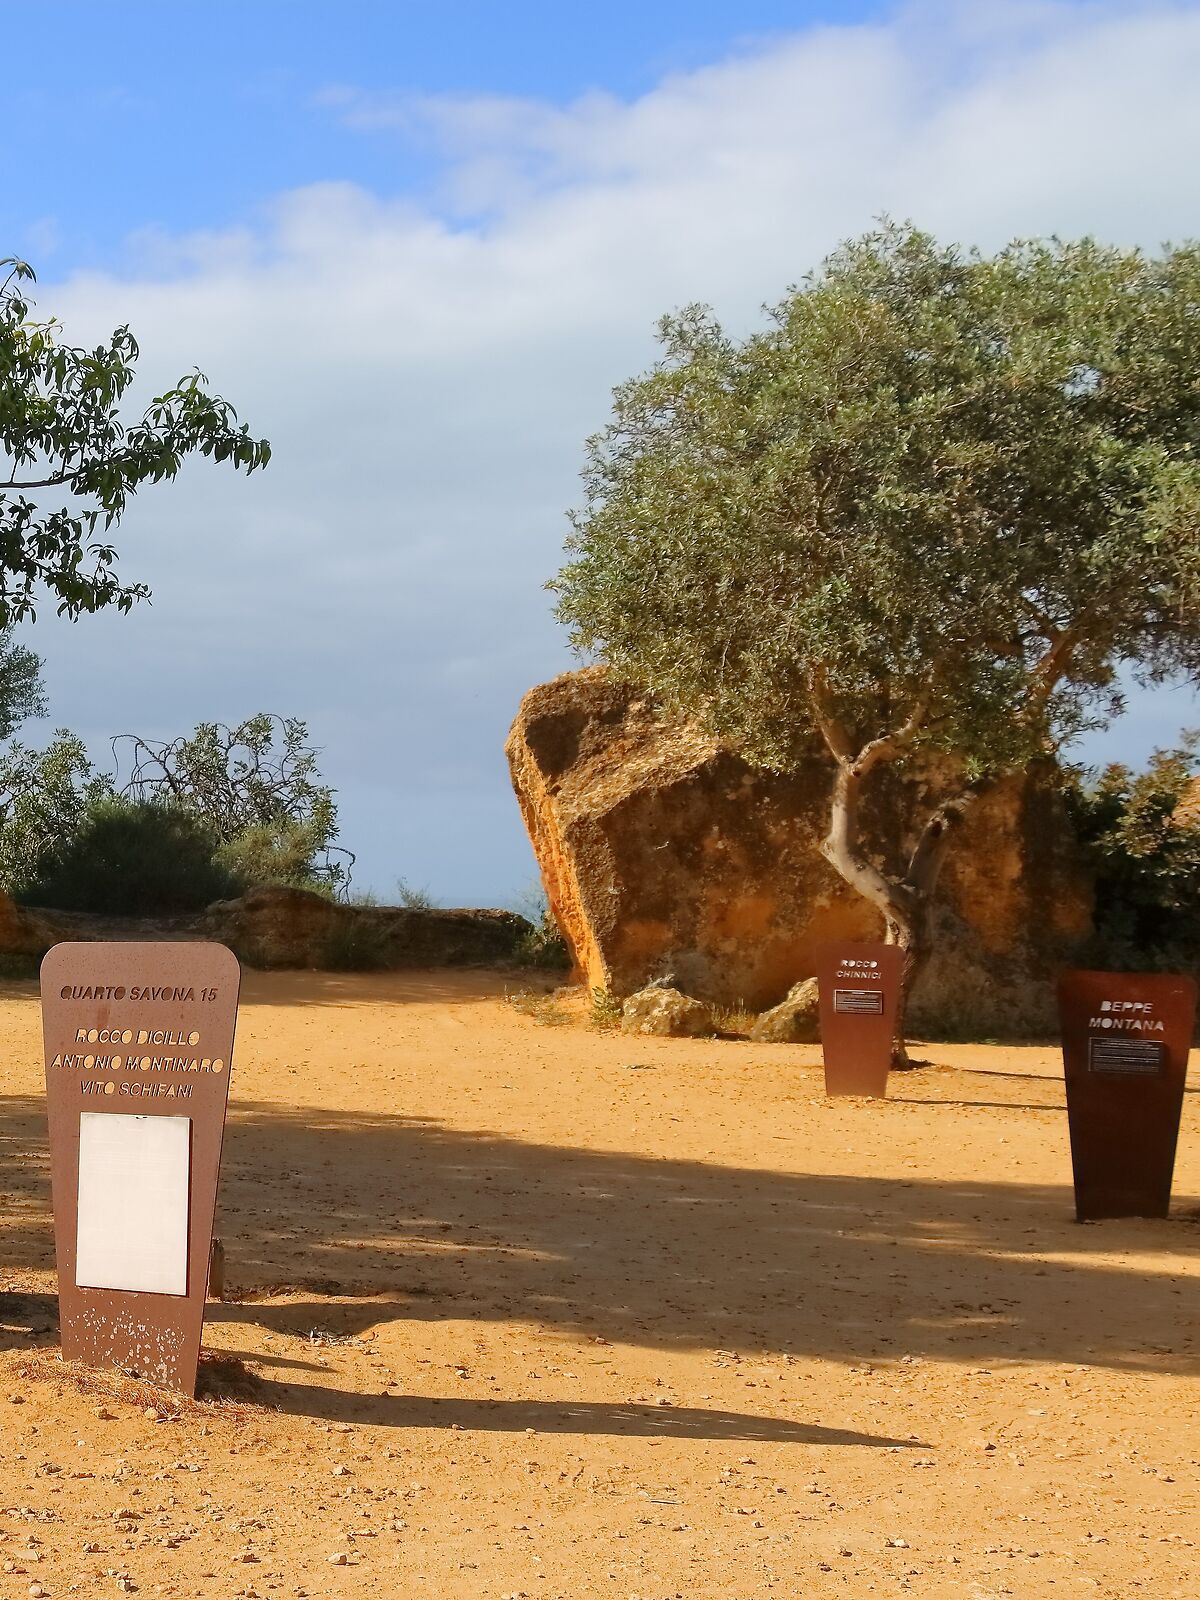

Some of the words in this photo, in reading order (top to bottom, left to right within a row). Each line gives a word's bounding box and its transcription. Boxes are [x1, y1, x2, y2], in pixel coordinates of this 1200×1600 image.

[841, 959, 878, 968] ROCCO
[836, 970, 882, 979] CHINNICI
[60, 985, 126, 1001] QUARTO
[129, 986, 194, 1001] SAVONA
[200, 987, 218, 1002] 15
[1100, 1000, 1153, 1013] BEPPE
[1089, 1017, 1164, 1031] MONTANA
[75, 1028, 133, 1044] ROCCO
[136, 1030, 200, 1046] DICILLO
[50, 1054, 122, 1070] ANTONIO
[125, 1056, 224, 1074] MONTINARO
[80, 1080, 115, 1095] VITO
[118, 1082, 193, 1098] SCHIFANI
